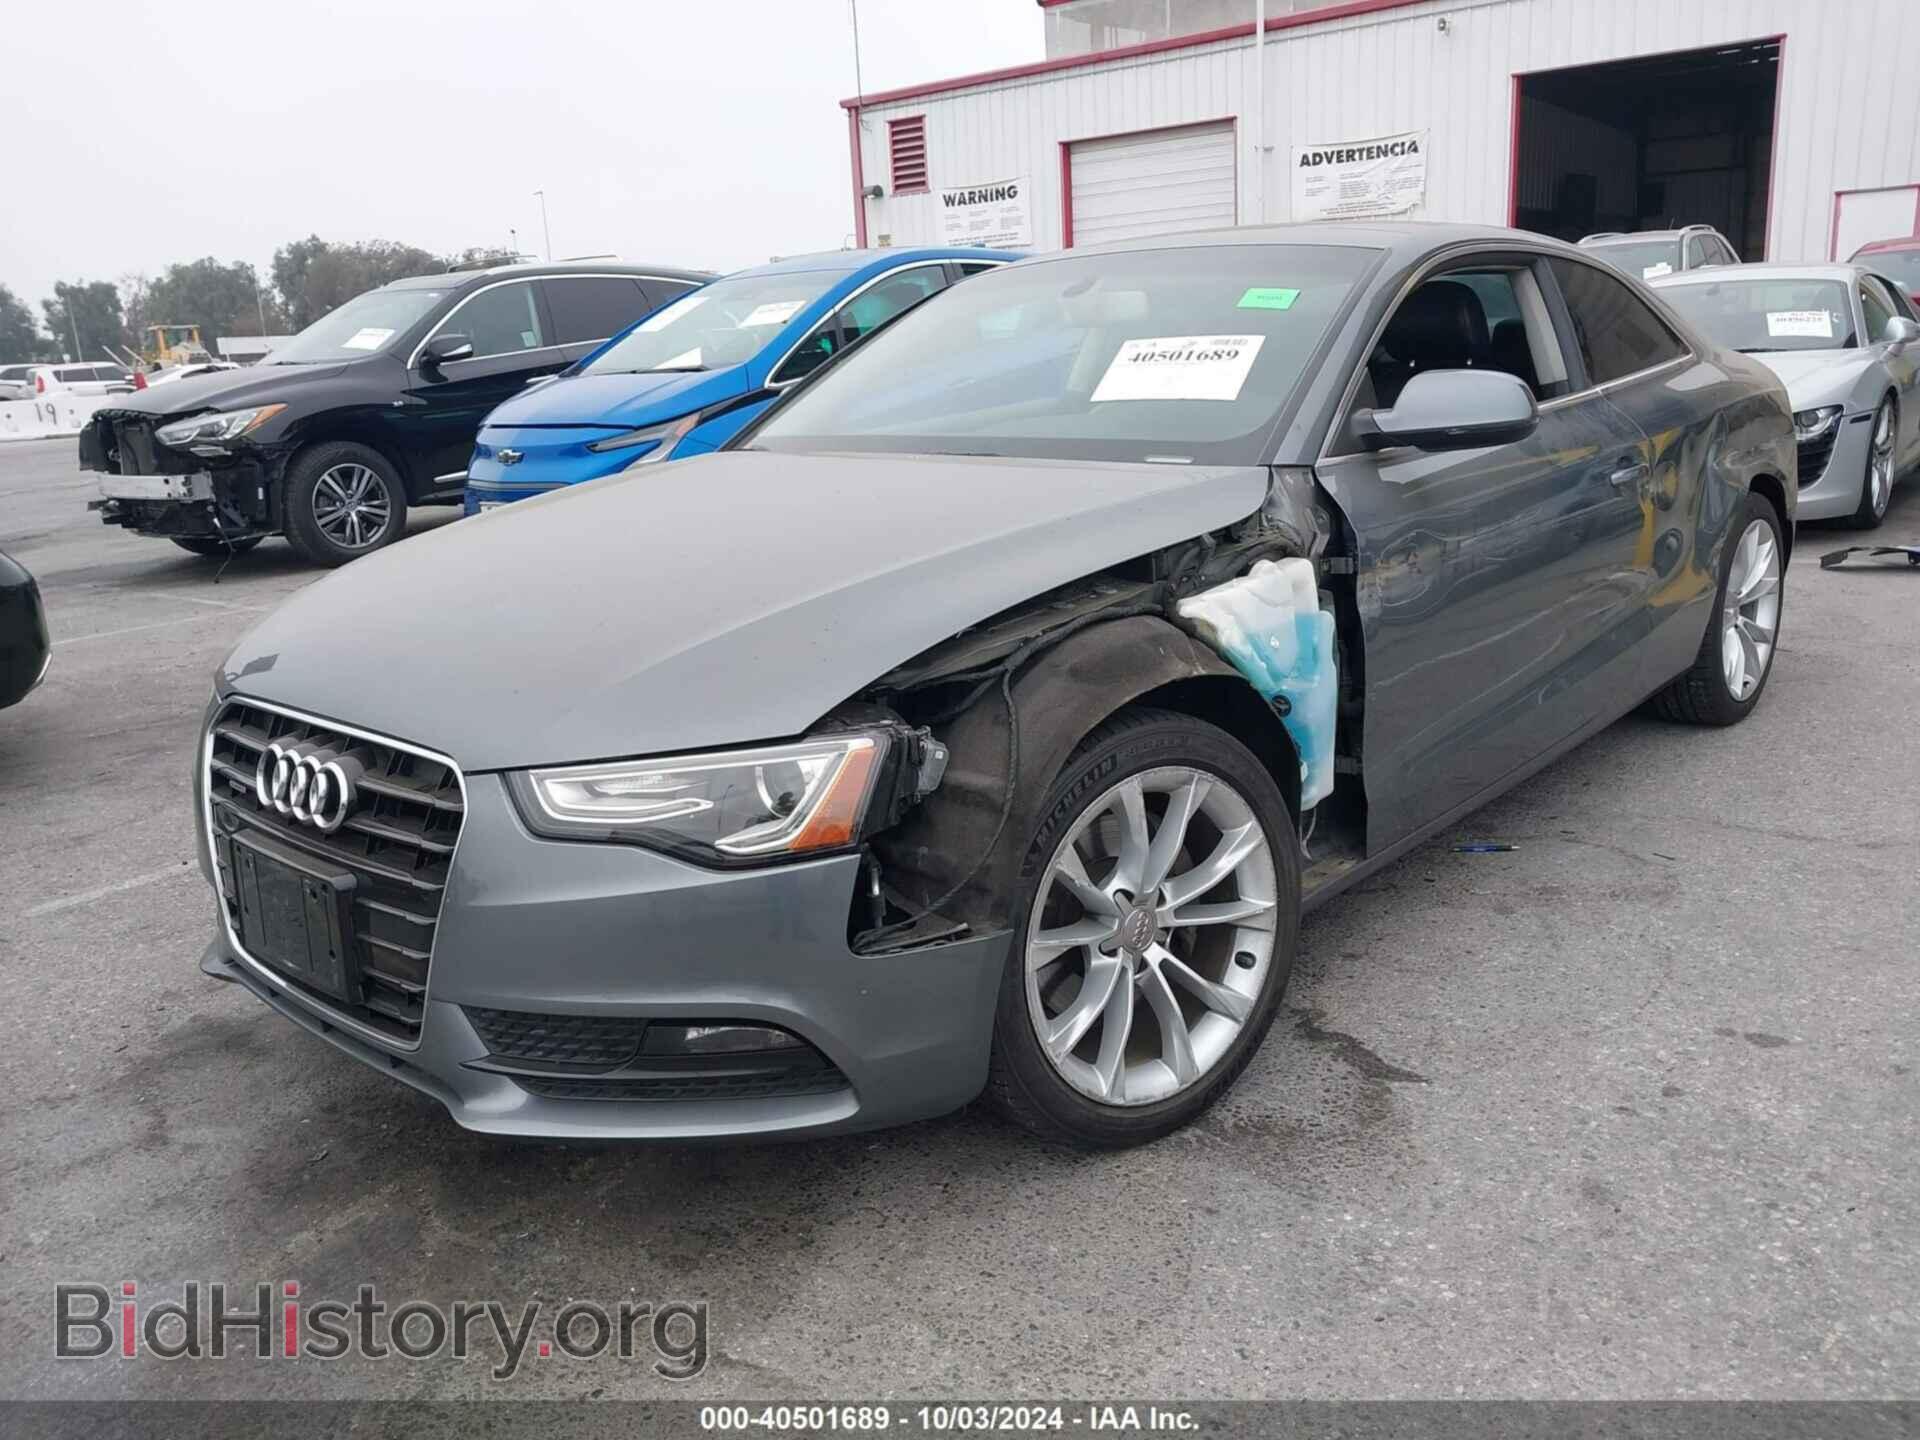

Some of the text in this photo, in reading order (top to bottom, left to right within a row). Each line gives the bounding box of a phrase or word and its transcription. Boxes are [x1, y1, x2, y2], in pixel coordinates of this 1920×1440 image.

[1299, 140, 1419, 167] ADVERTENCIA
[943, 185, 1019, 208] WARNING
[1128, 349, 1240, 364] 40501689
[35, 403, 57, 425] 19
[1036, 758, 1114, 847] MICHELIN
